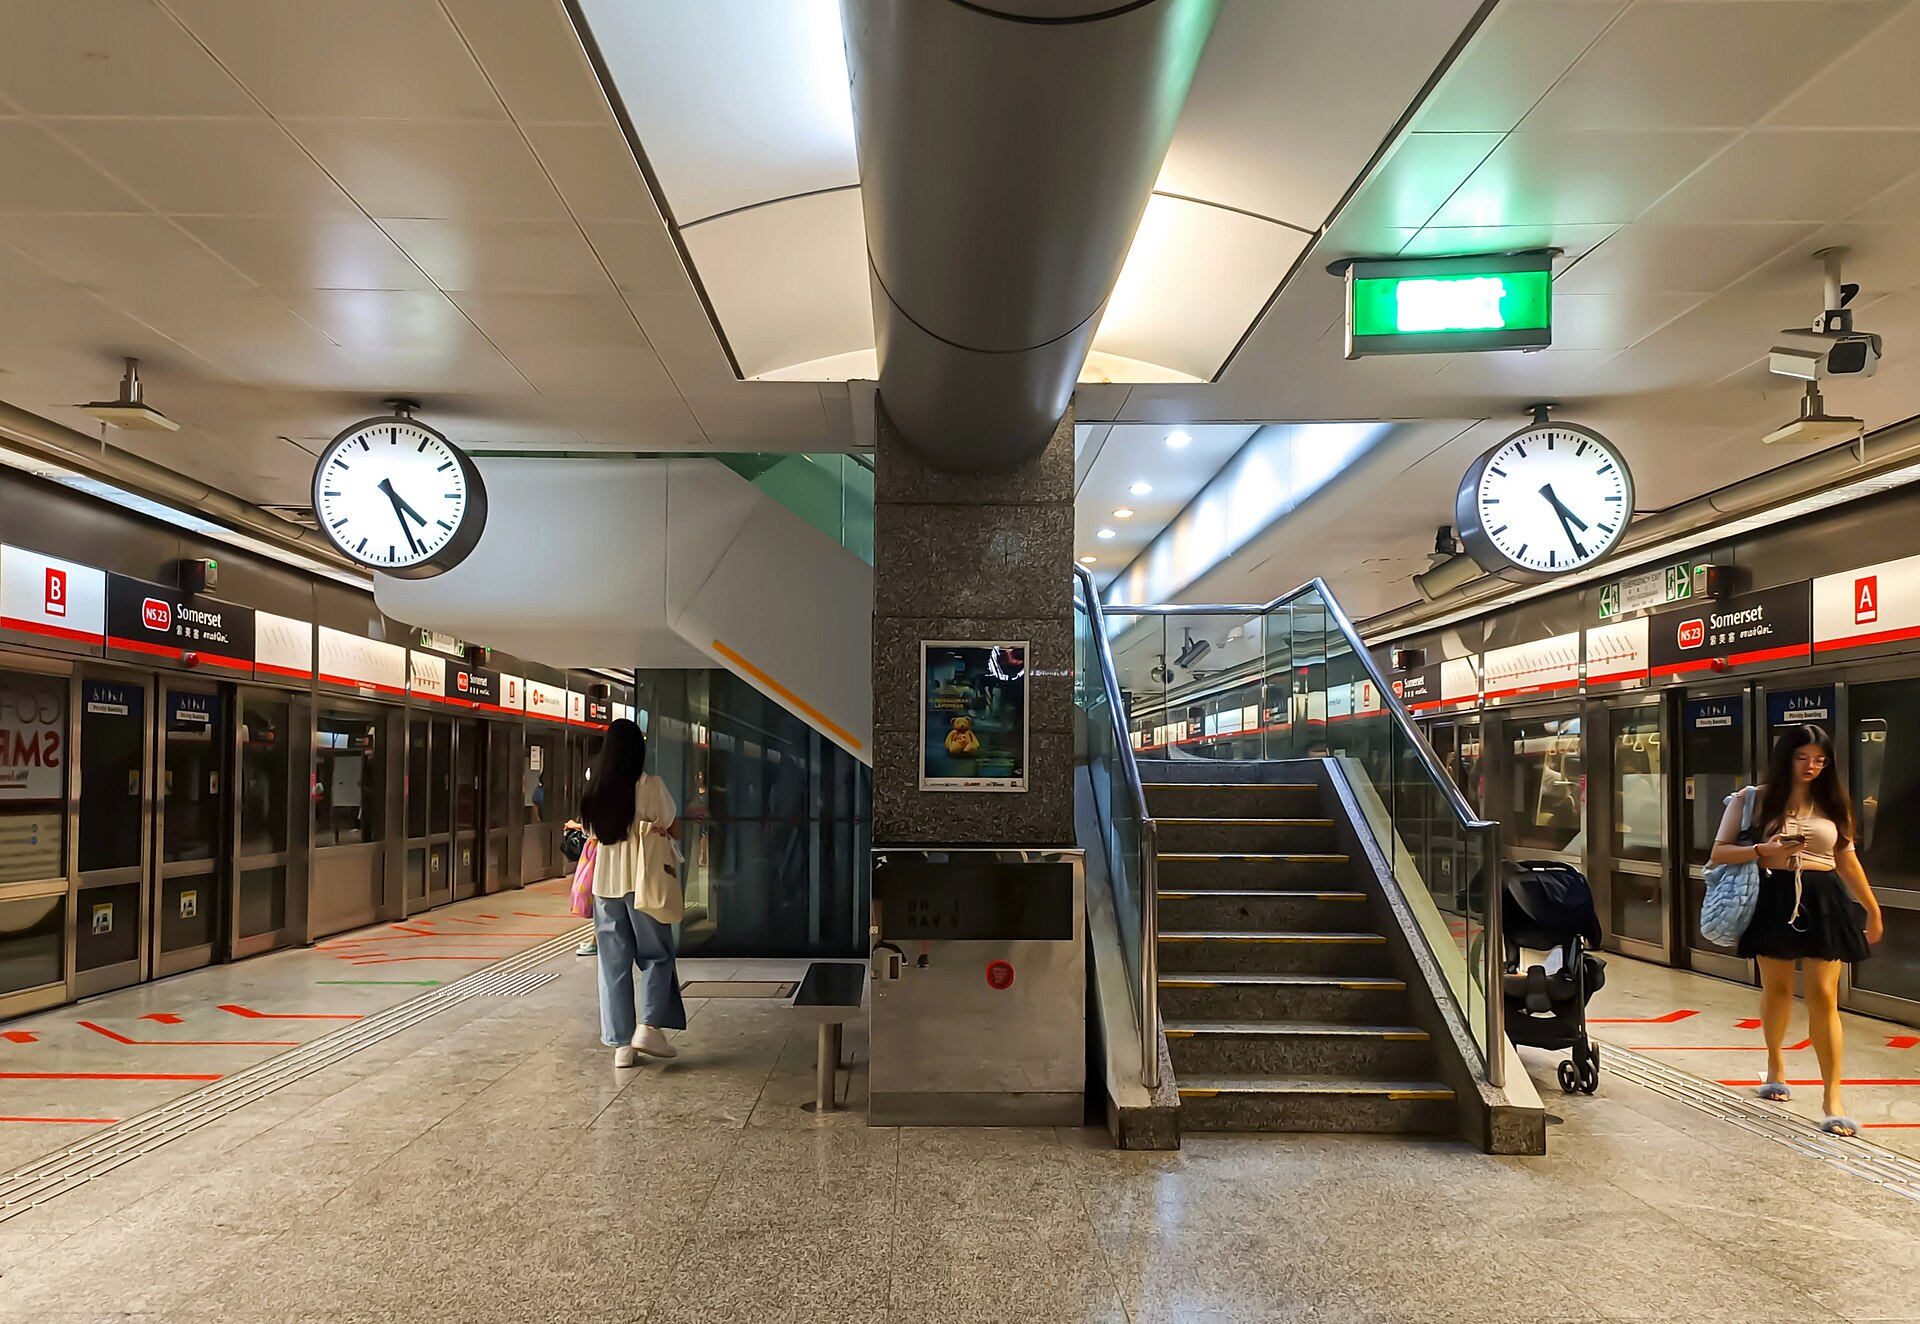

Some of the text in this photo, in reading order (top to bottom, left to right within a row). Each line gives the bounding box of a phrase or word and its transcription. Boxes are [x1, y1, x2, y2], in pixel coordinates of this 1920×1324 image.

[51, 576, 61, 600] B
[1859, 584, 1873, 609] A
[177, 603, 222, 628] Somerset
[1710, 604, 1763, 630] Somerset
